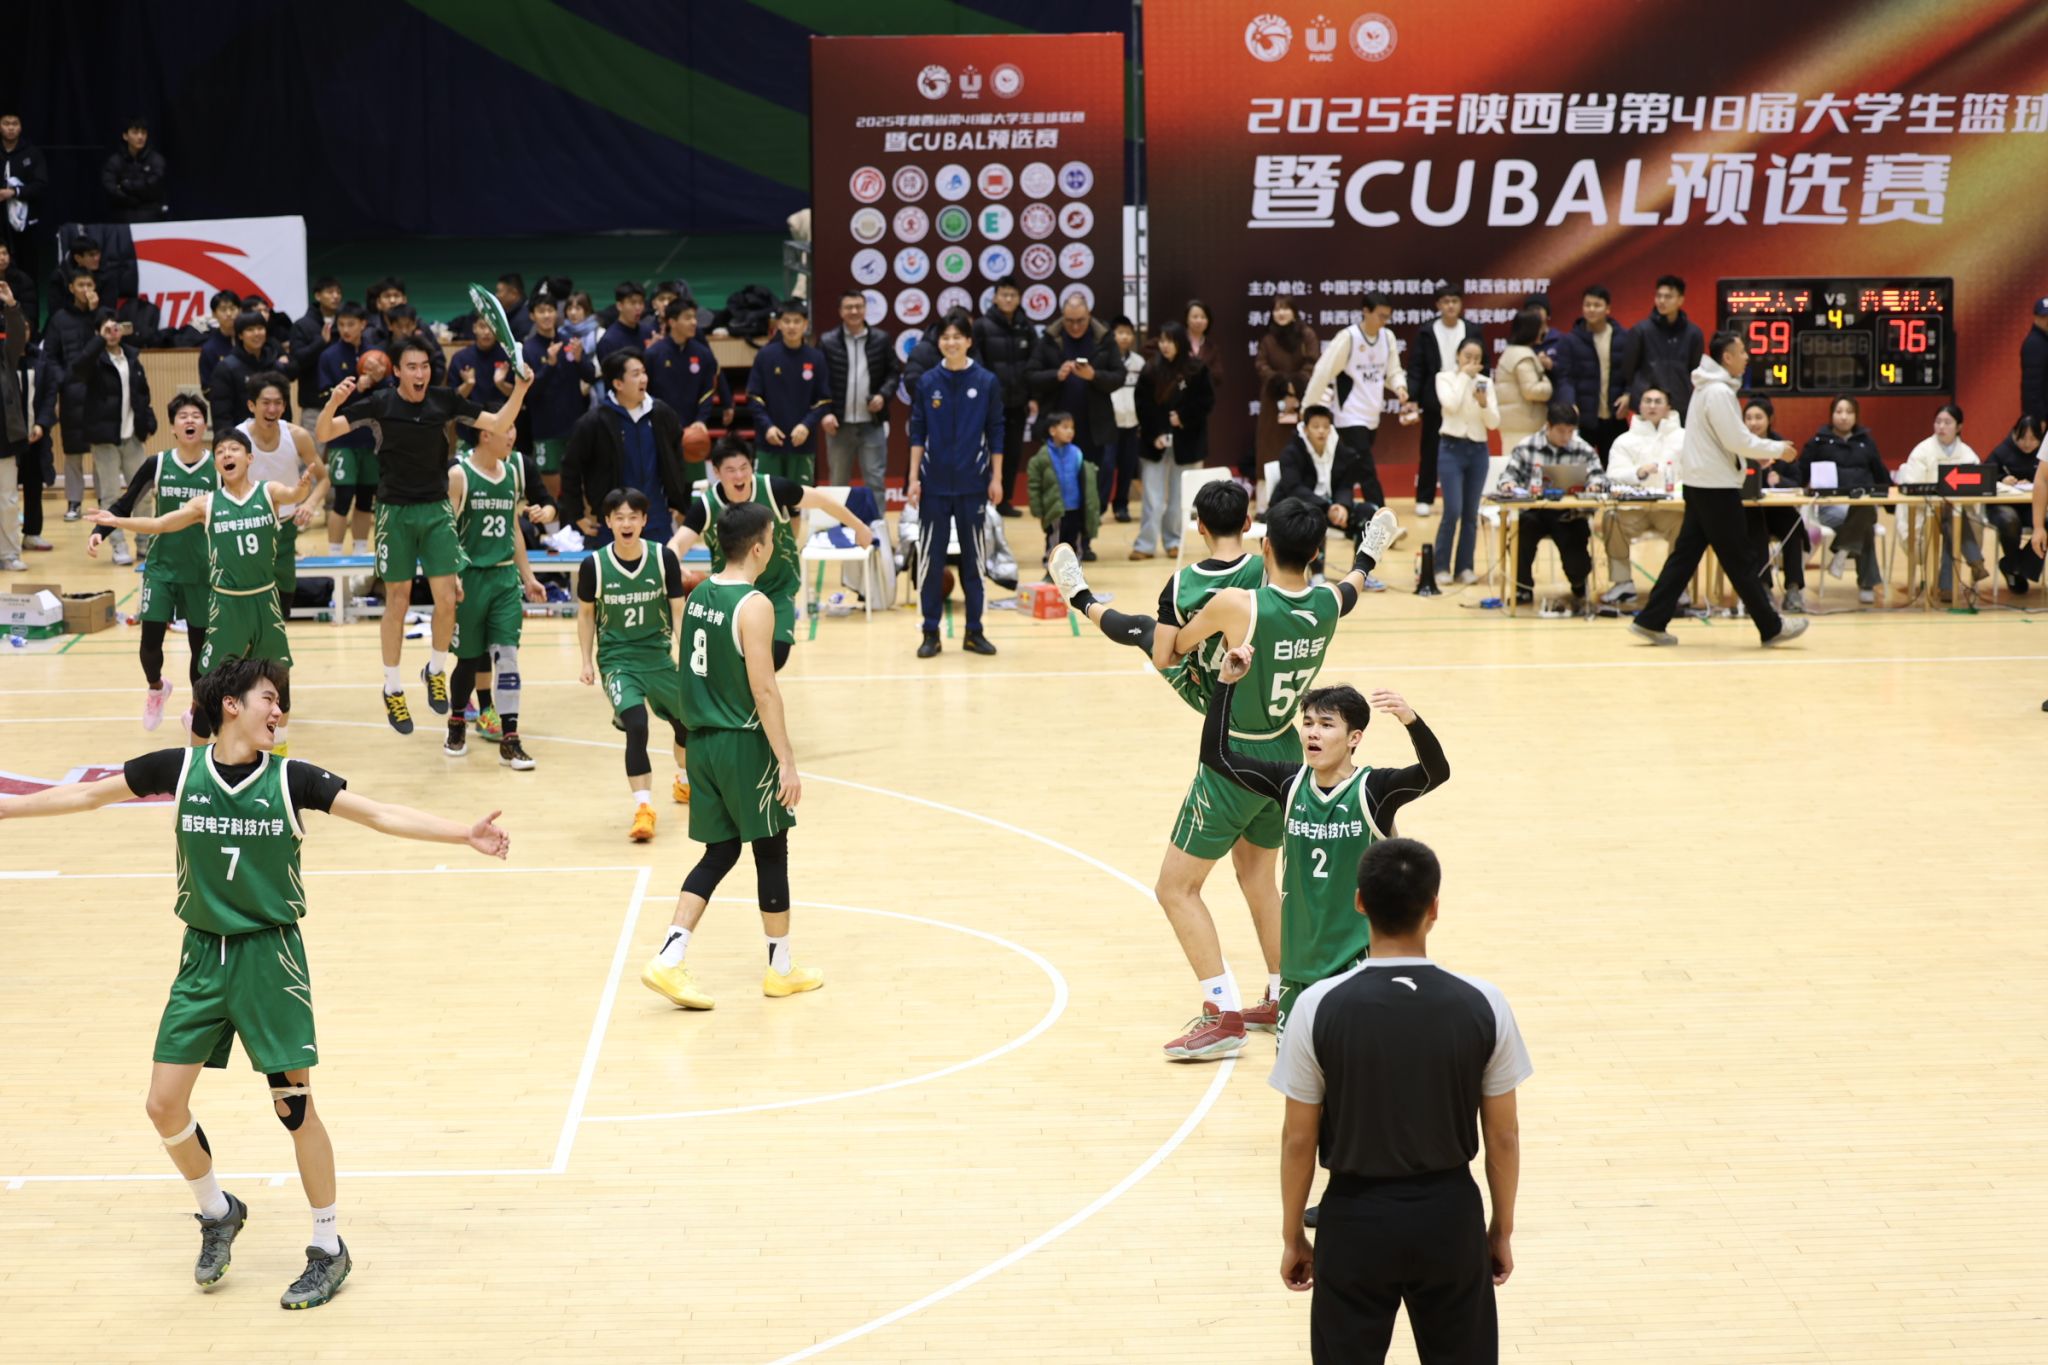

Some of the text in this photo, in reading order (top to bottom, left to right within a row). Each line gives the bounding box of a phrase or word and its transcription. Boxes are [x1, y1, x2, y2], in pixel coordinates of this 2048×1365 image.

[1247, 92, 2048, 135] 2025年陕西省第48届大学生篮球
[883, 128, 1060, 152] 暨CUBAL预选赛
[1247, 153, 1953, 228] 暨CUBAL预选赛
[1824, 293, 1847, 306] VS
[1828, 309, 1842, 329] 4
[1750, 321, 1790, 354] 59
[1889, 320, 1927, 353] 76
[1773, 364, 1787, 385] 4
[1880, 363, 1895, 384] 4
[481, 515, 506, 538] 23
[236, 533, 260, 556] 19
[624, 606, 645, 629] 21
[690, 628, 708, 678] 8
[1268, 666, 1317, 717] 57
[181, 814, 284, 836] 西安电子科技大学
[1287, 818, 1363, 840] 西安电子科技大学
[220, 846, 241, 881] 7
[1311, 848, 1328, 878] 2
